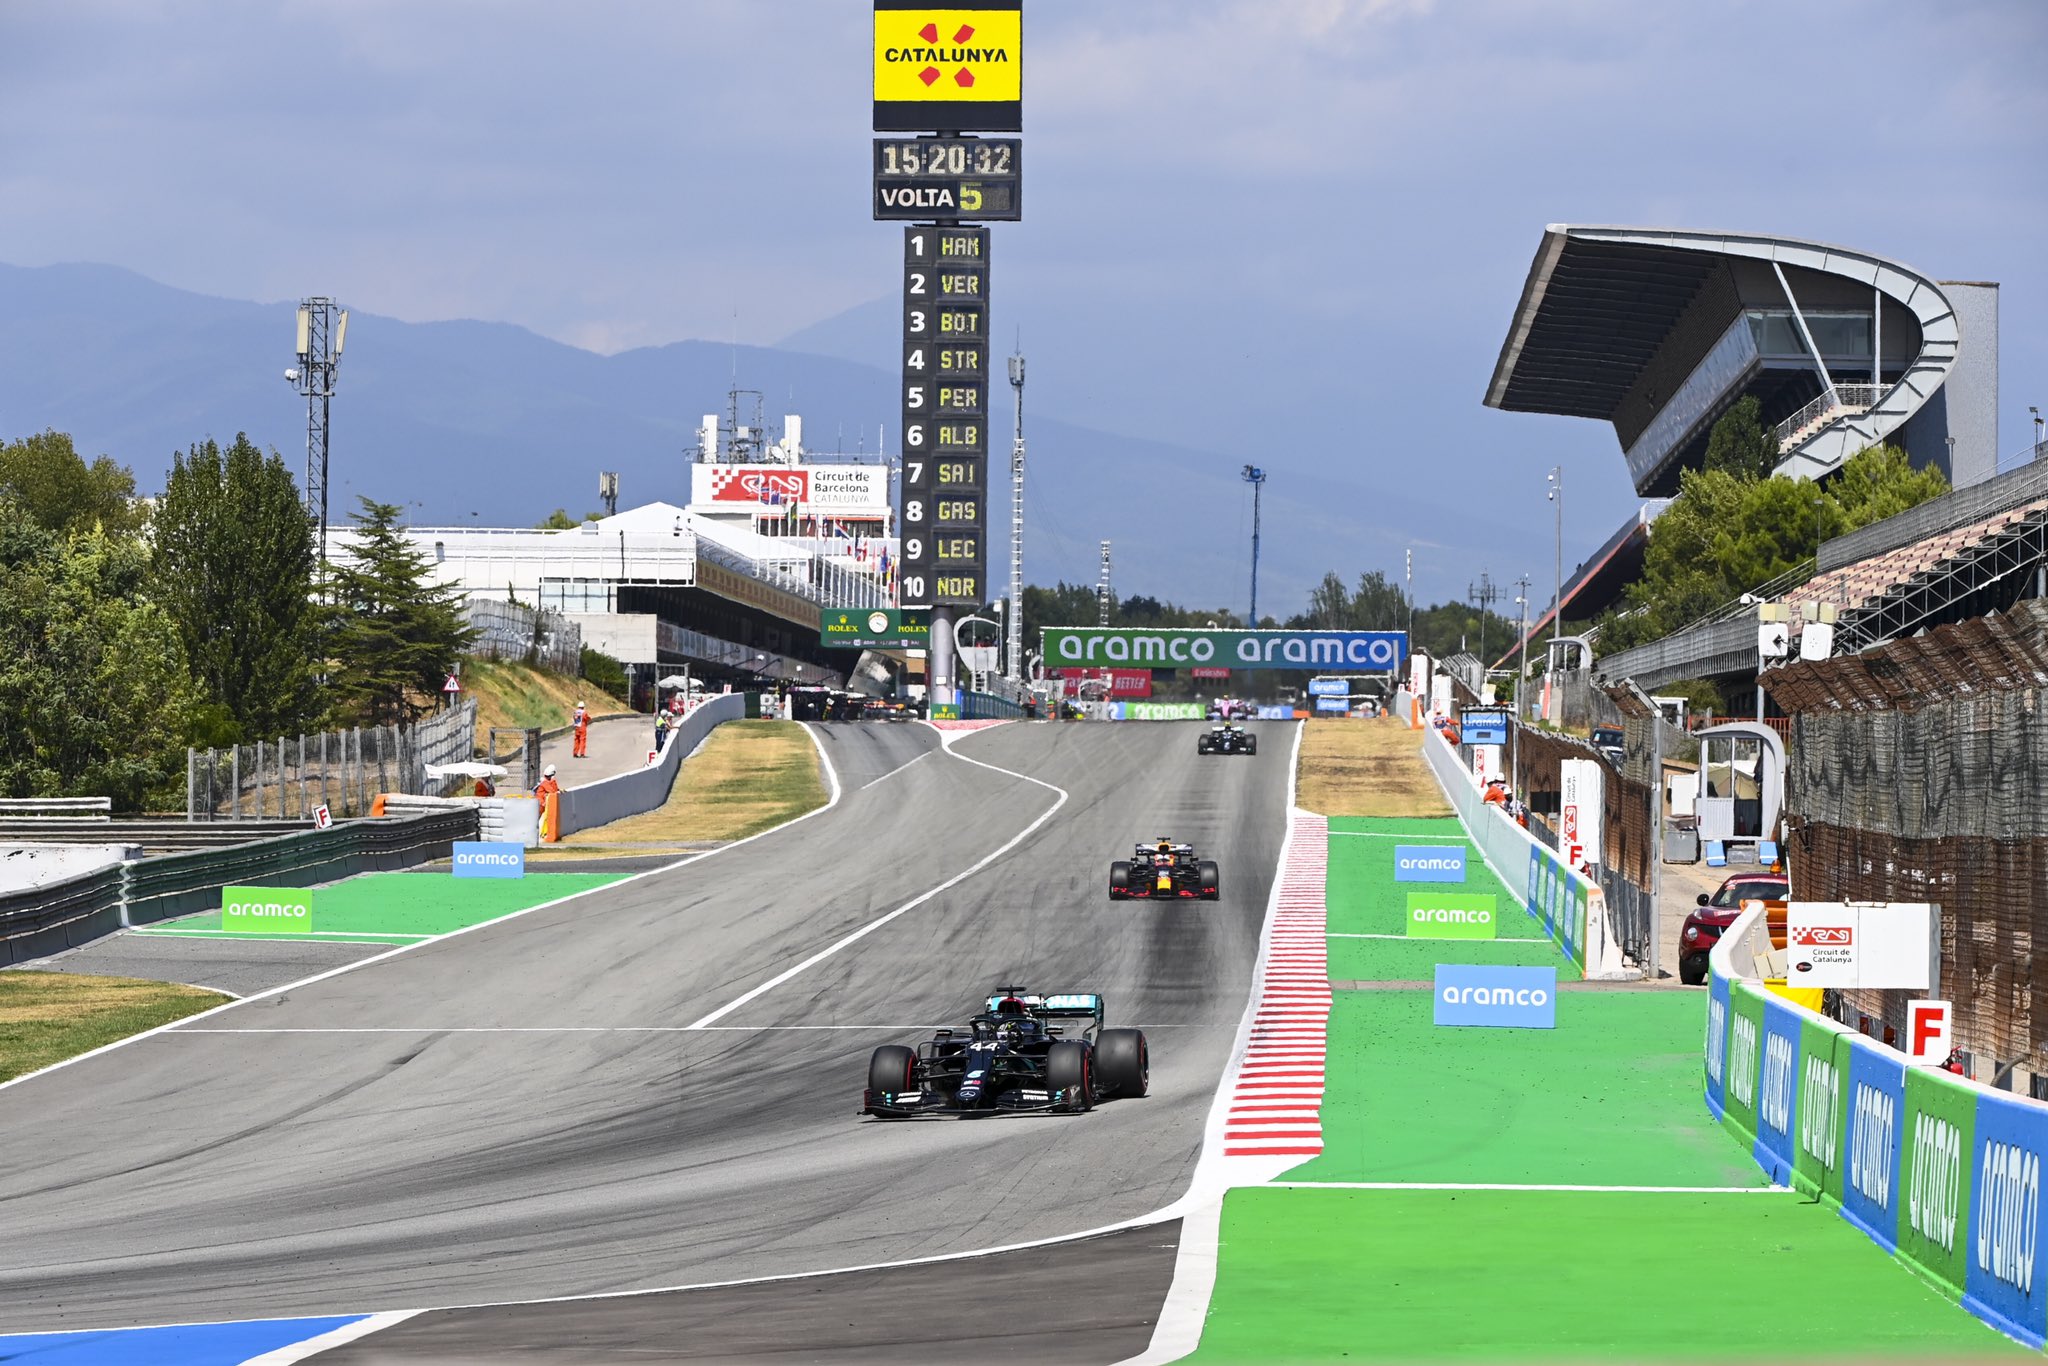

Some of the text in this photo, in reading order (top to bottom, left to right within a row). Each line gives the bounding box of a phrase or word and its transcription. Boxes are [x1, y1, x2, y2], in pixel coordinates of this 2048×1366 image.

[885, 48, 1008, 62] CATALUNYA
[883, 144, 1011, 175] 15:20:32
[881, 182, 983, 211] VOLTA 5
[911, 235, 979, 256] 1 HAM
[910, 273, 979, 294] 2 VER
[910, 311, 978, 332] 3 BOT
[908, 350, 978, 370] 4 STR
[908, 387, 977, 408] 5 PER
[907, 425, 977, 446] 6 ALB
[815, 471, 870, 482] Circuit de
[907, 463, 974, 483] 7 SAI
[815, 483, 869, 493] Barcelona
[814, 494, 870, 503] CATALUNYA
[906, 501, 976, 522] 8 GAS
[906, 539, 975, 560] 9 LEC
[903, 576, 975, 598] 10 NOR
[827, 625, 859, 633] ROLEX
[898, 625, 928, 633] ROLEX
[1059, 635, 1215, 662] aramco
[1237, 638, 1393, 664] aramco
[689, 701, 695, 709] F
[649, 752, 656, 764] F
[318, 808, 328, 826] F
[457, 853, 519, 866] aramco
[1400, 857, 1461, 871] aramco
[1570, 846, 1583, 865] F
[228, 902, 306, 918] aramco
[1413, 908, 1491, 924] aramco
[1813, 956, 1852, 964] Catalunya
[1442, 986, 1548, 1008] aramco
[1913, 1008, 1944, 1056] F
[970, 1042, 998, 1051] 44
